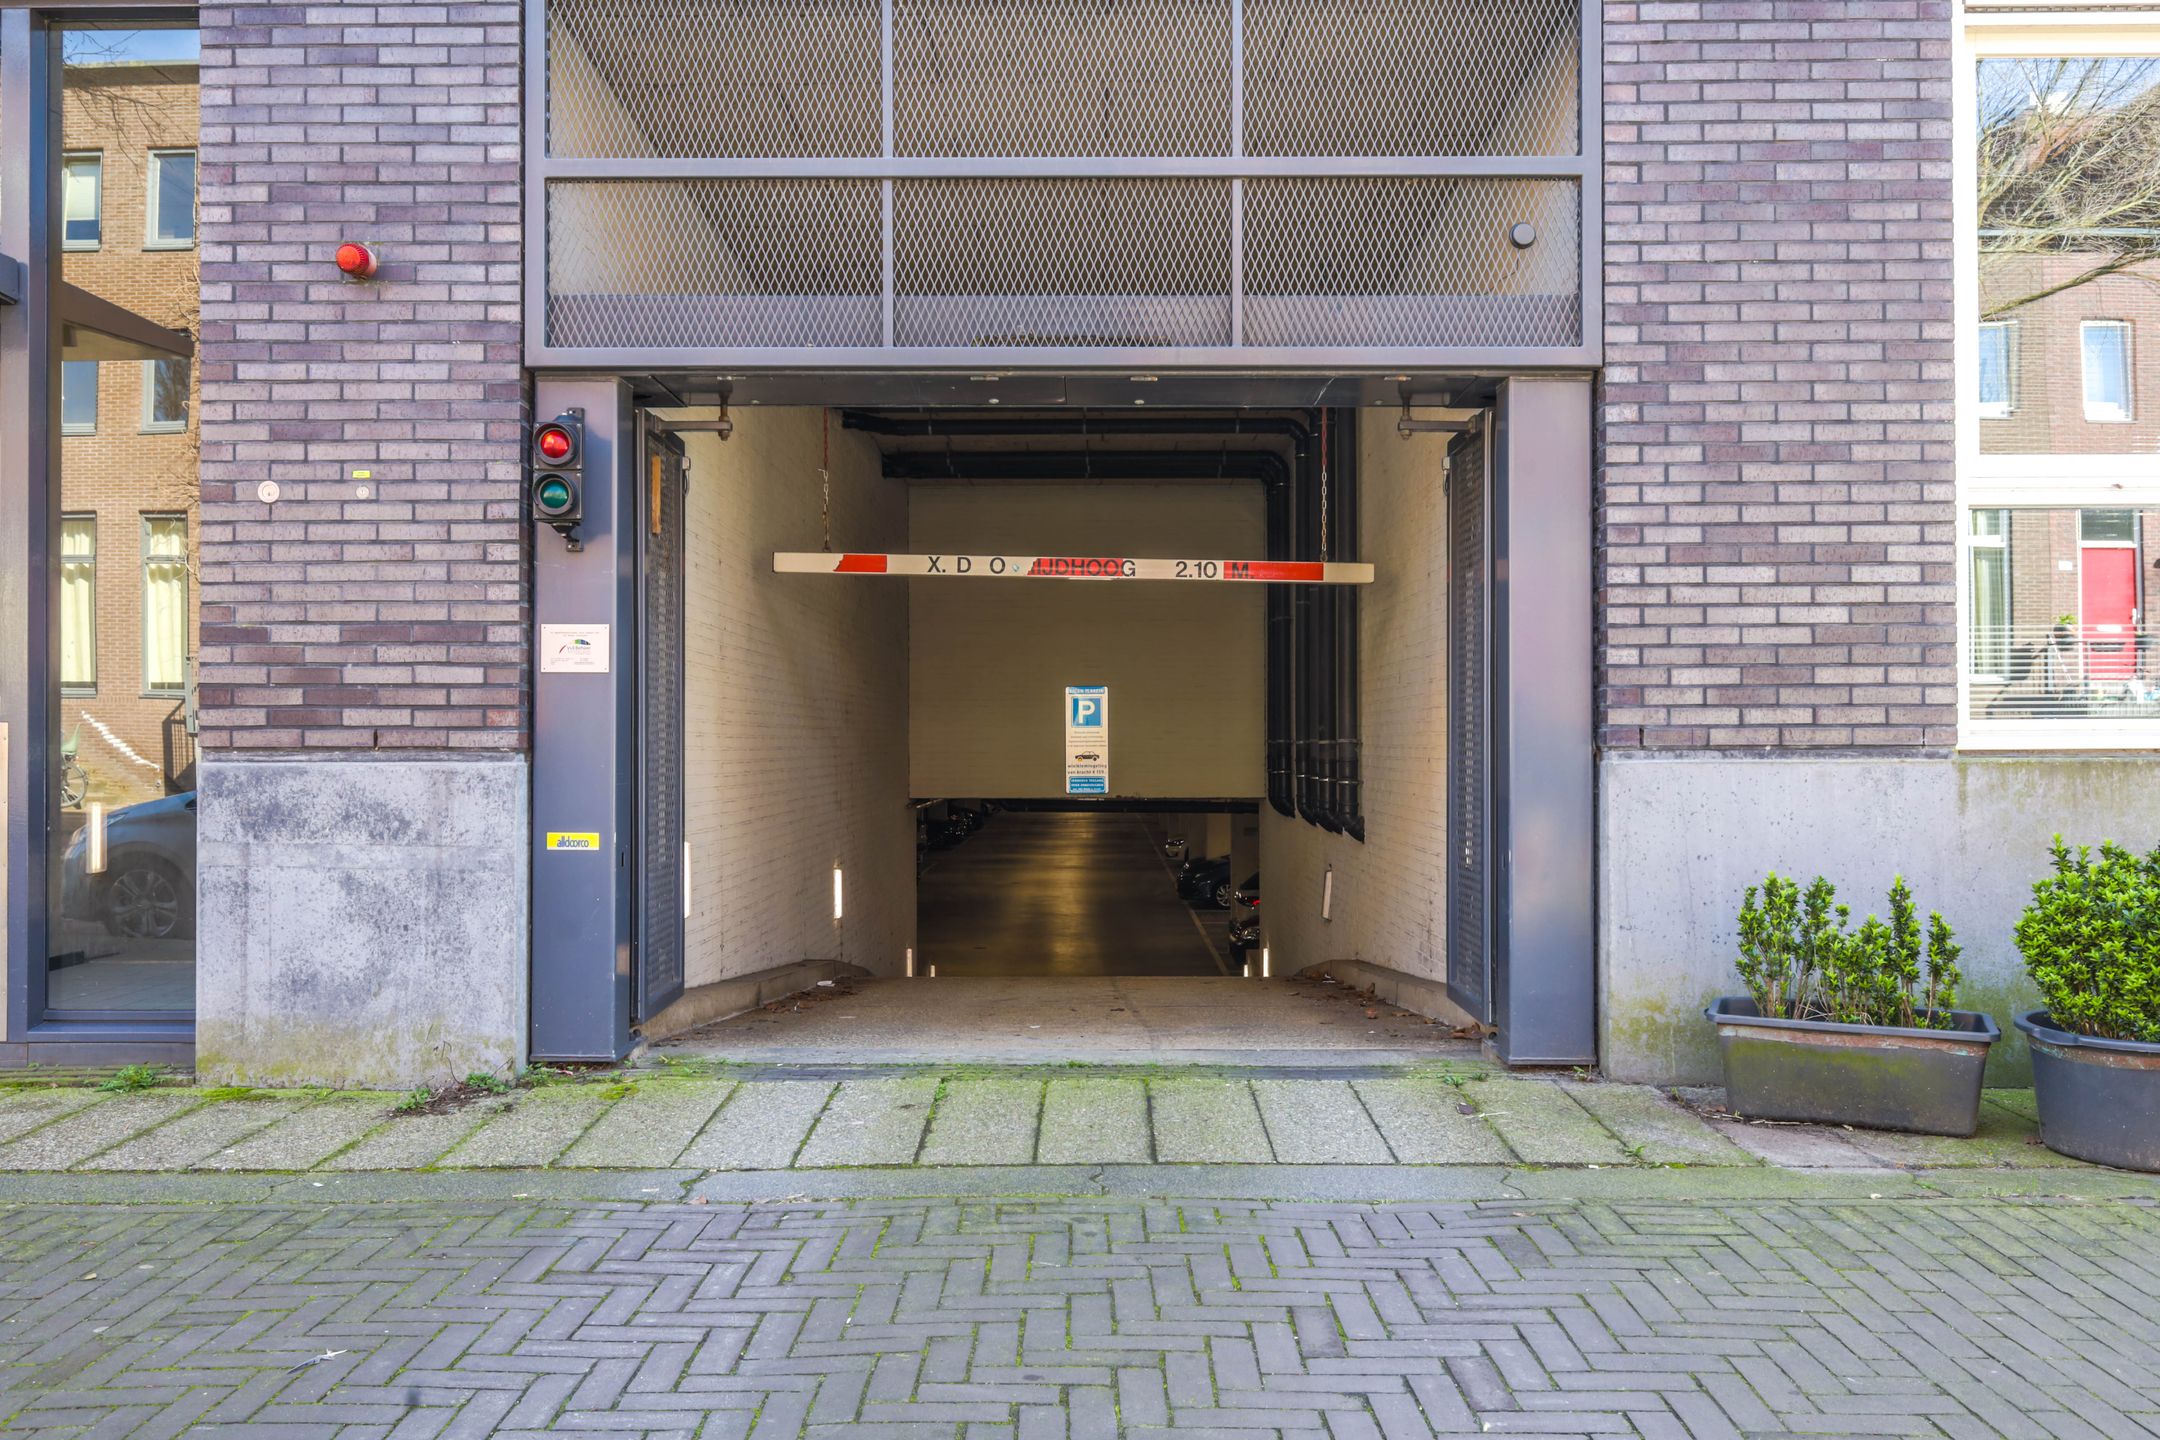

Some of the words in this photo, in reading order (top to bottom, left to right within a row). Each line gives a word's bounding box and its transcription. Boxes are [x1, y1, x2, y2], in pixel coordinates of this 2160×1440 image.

[1175, 560, 1218, 579] 2.10
[1078, 700, 1096, 724] P
[557, 836, 589, 848] alldoorco
